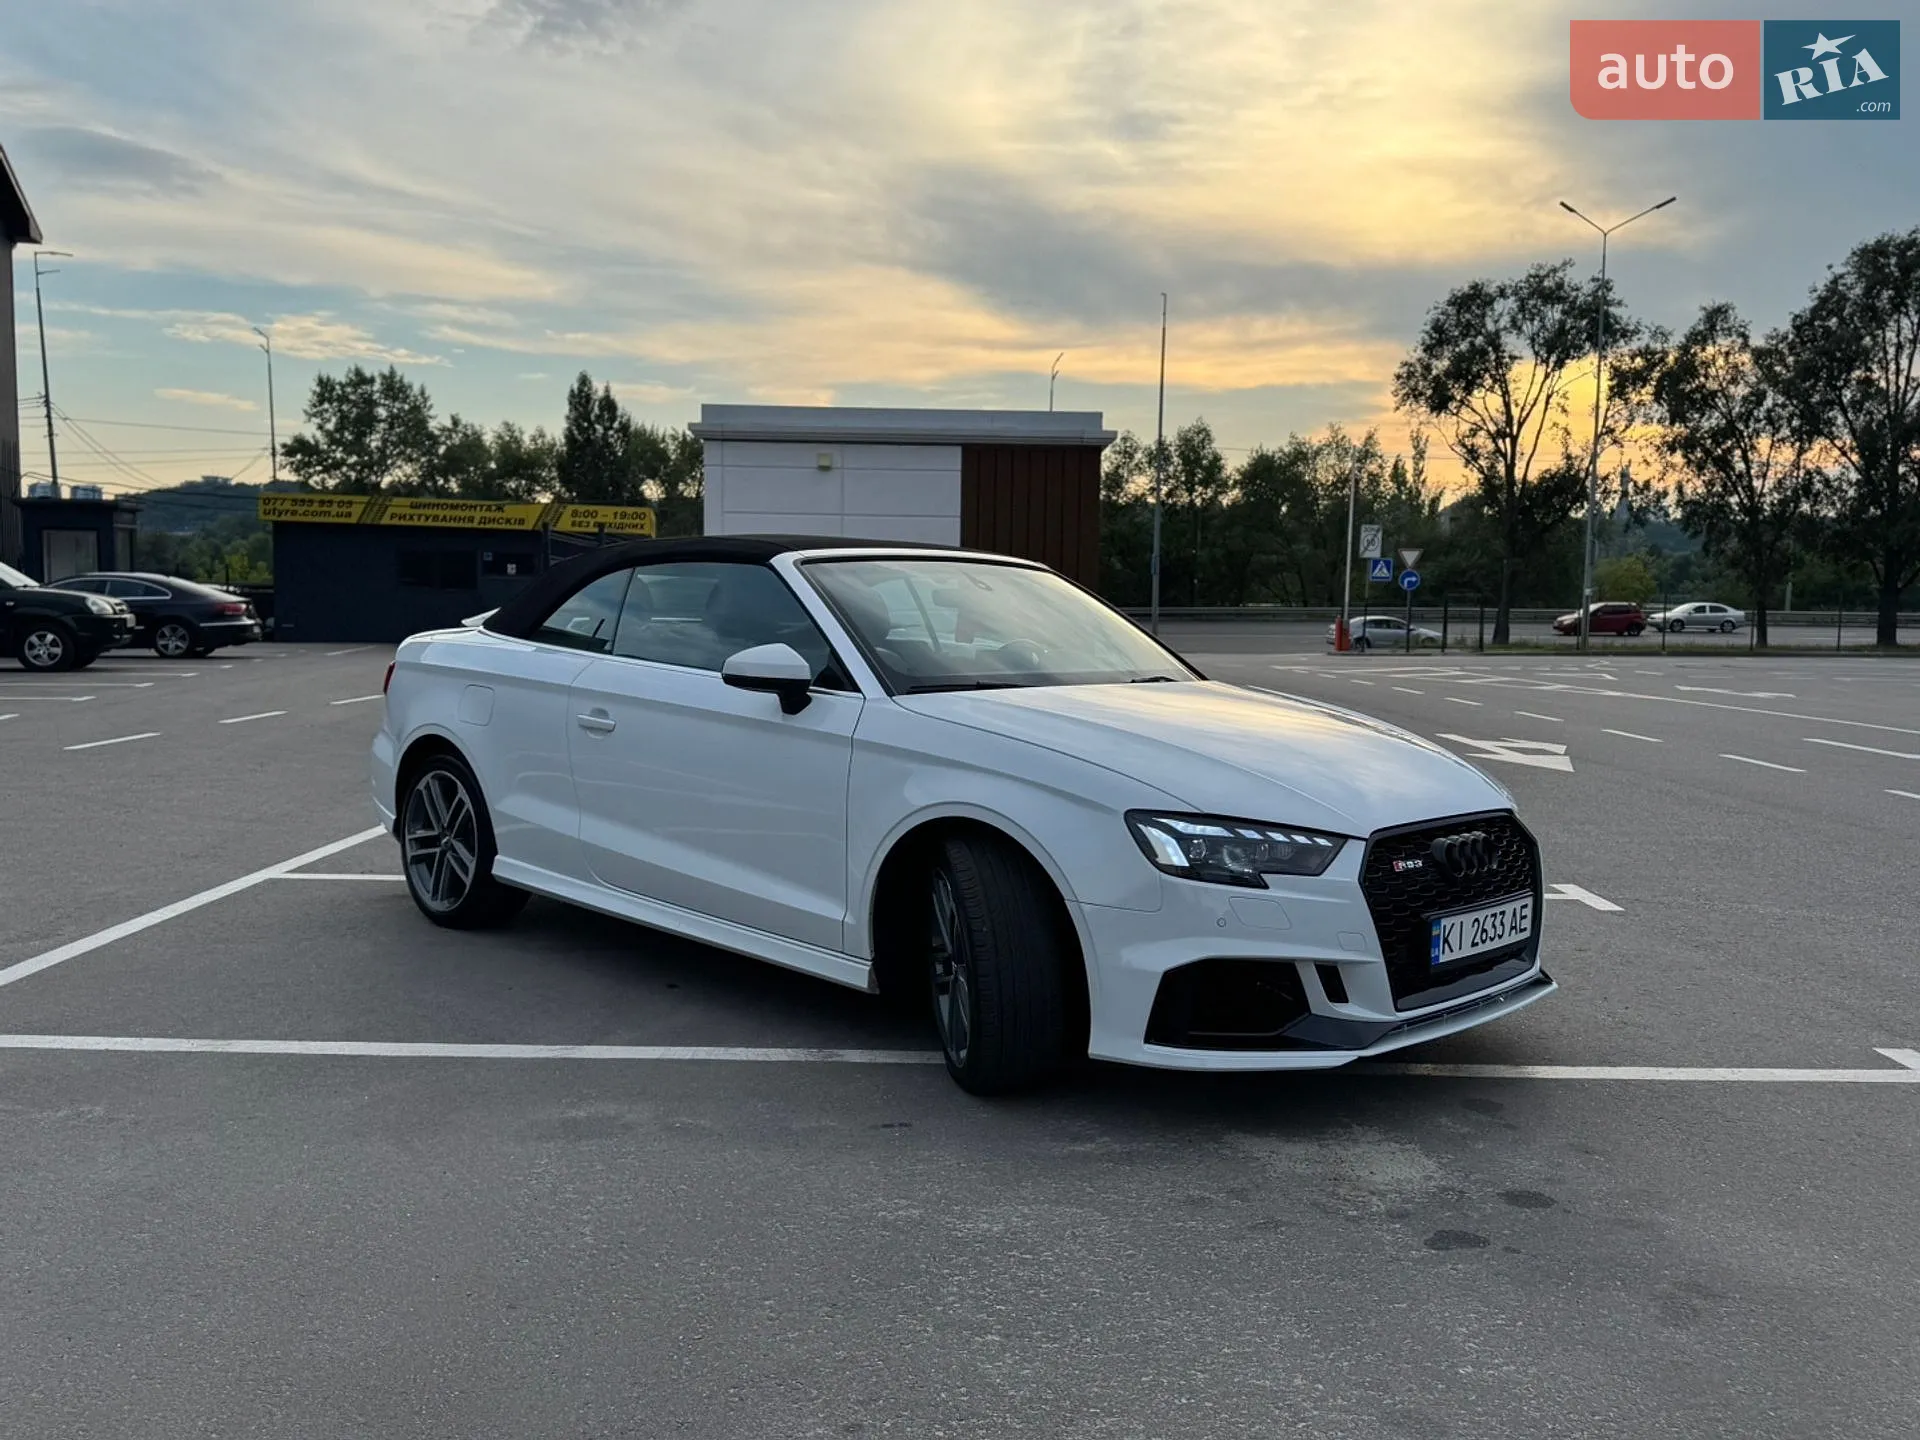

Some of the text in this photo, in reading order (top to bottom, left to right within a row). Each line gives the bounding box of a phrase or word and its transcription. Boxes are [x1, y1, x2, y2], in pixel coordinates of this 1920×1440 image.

[262, 497, 287, 506] 077
[409, 501, 505, 513] ШИНОМОНТАЖ
[262, 507, 353, 518] utyre.com.ua
[571, 509, 598, 519] 8:00
[613, 510, 646, 520] 19:00
[389, 512, 525, 526] РИХТУВАННЯ ДИСКІВ
[571, 520, 645, 530] БЕЗ ВХІДНИХ
[1442, 903, 1529, 955] KI 2633 AE
